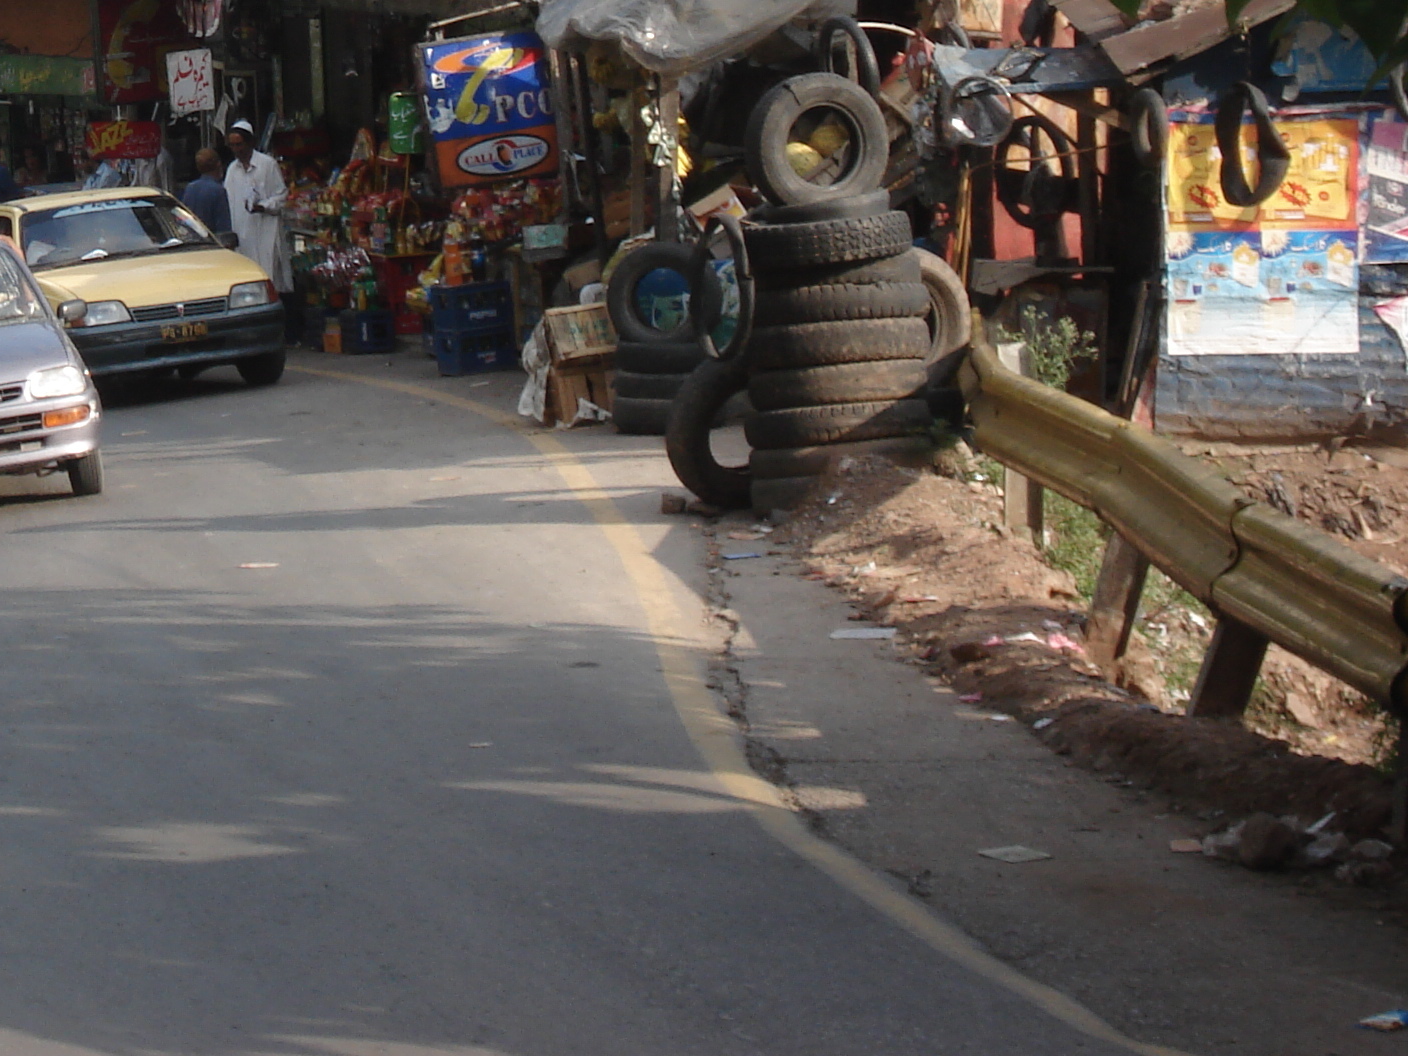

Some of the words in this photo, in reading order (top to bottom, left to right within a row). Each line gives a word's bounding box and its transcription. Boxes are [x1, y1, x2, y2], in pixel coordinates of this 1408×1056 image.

[89, 121, 134, 157] JAZZ
[465, 152, 496, 166] CALL
[513, 145, 543, 159] PLACE
